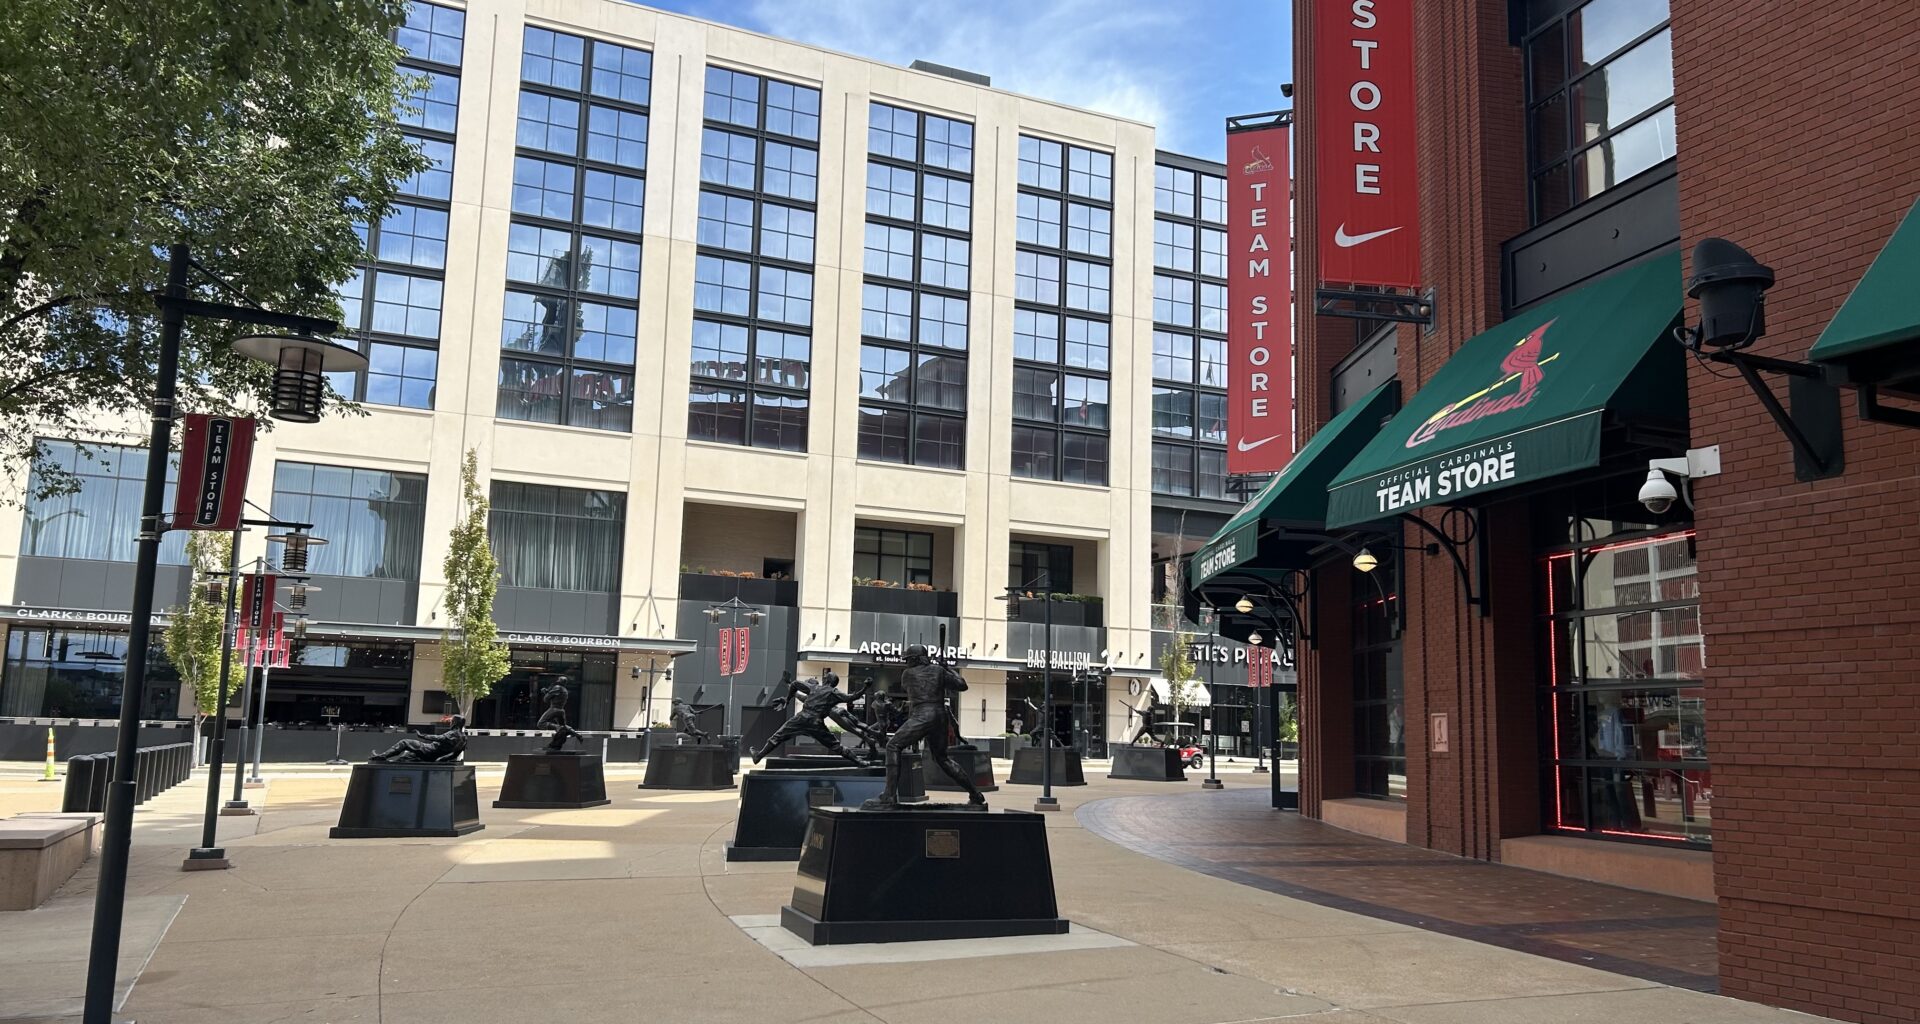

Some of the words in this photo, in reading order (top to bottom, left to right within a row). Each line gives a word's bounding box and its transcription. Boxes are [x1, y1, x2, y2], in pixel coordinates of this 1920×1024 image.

[1349, 0, 1382, 195] STORE
[1249, 182, 1270, 278] TEAM
[1249, 296, 1270, 417] STORE
[211, 425, 224, 464] TEAM
[1379, 466, 1430, 488] OFFICIAL
[1439, 441, 1513, 469] CARDINALS
[204, 471, 218, 520] STORE
[1376, 475, 1431, 513] TEAM
[1437, 451, 1516, 496] STORE
[1200, 556, 1214, 580] TEAM
[1214, 544, 1236, 571] STORE
[16, 609, 72, 620] CLARK
[75, 611, 83, 620] &
[86, 613, 161, 624] BOURN
[508, 634, 552, 643] CLARK
[553, 635, 560, 643] &
[561, 636, 620, 647] BOURBON
[858, 641, 902, 655] ARCH
[909, 644, 973, 659] PAREL
[1027, 649, 1091, 675] BASBALLISM
